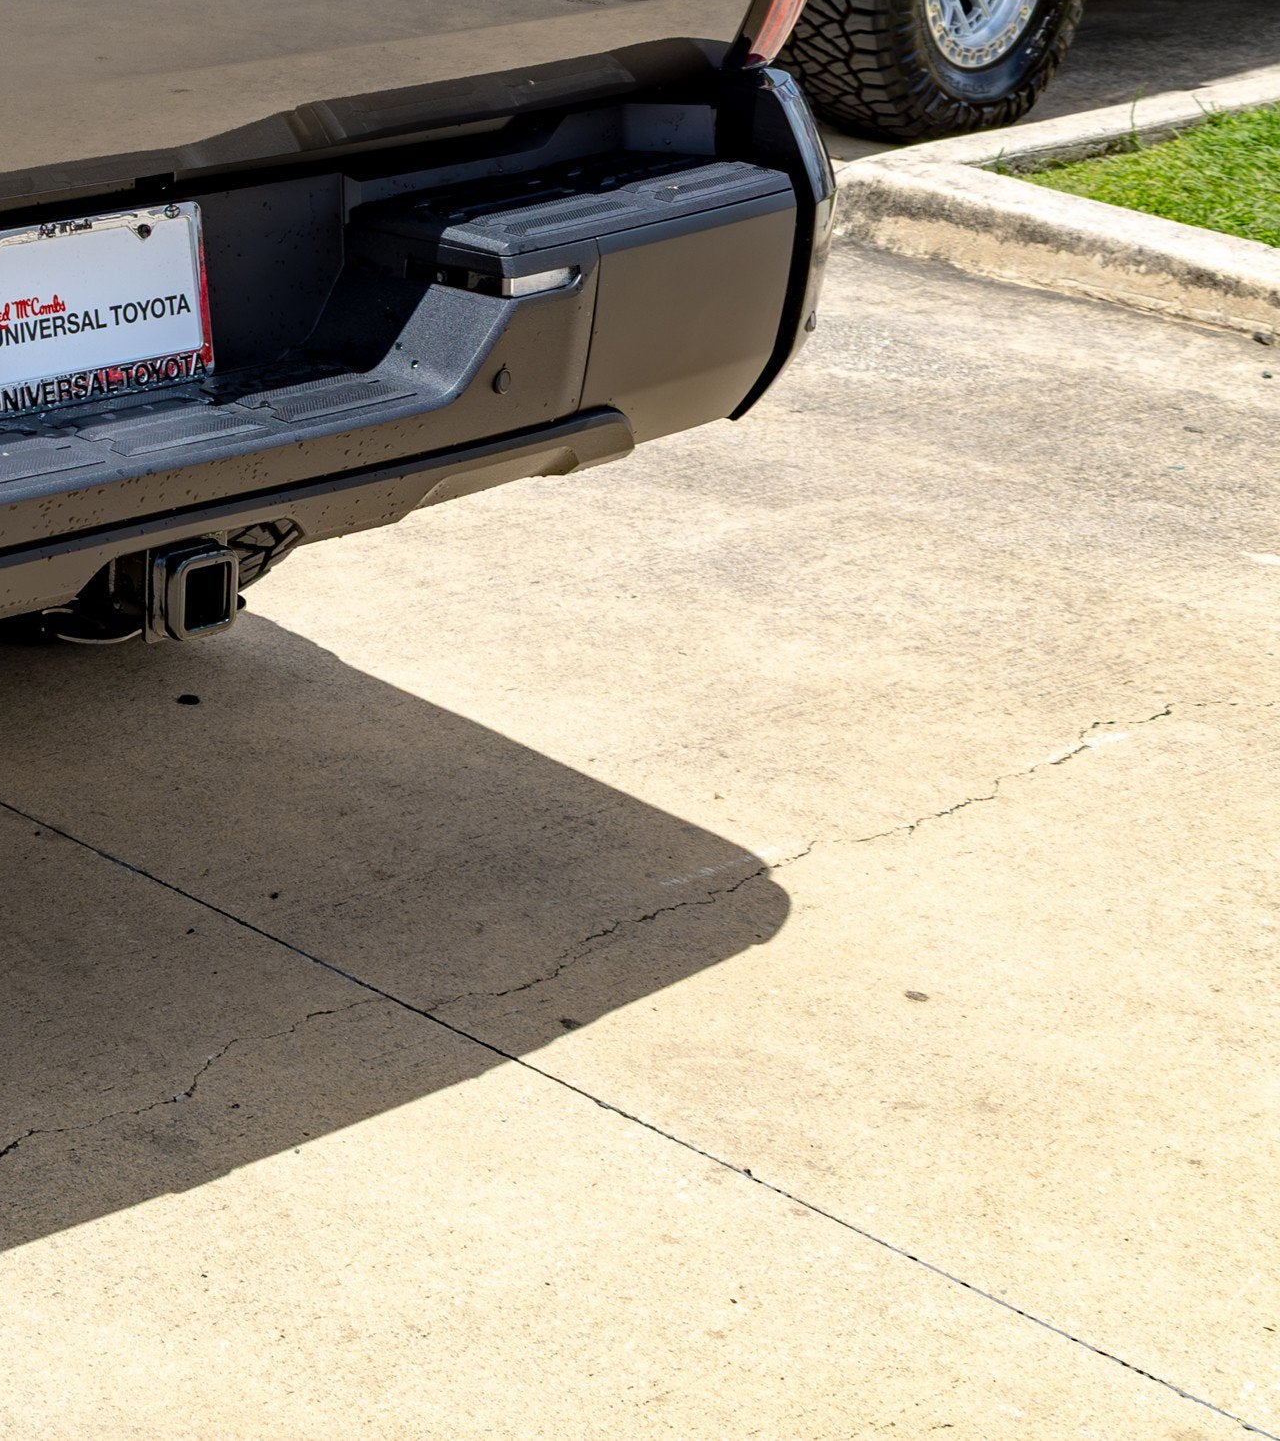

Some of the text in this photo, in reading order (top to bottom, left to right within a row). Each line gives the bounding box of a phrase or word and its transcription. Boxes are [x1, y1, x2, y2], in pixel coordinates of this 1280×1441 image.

[11, 294, 66, 319] McCombs
[110, 293, 191, 325] TOYOTA
[121, 352, 207, 387] TOYOTA
